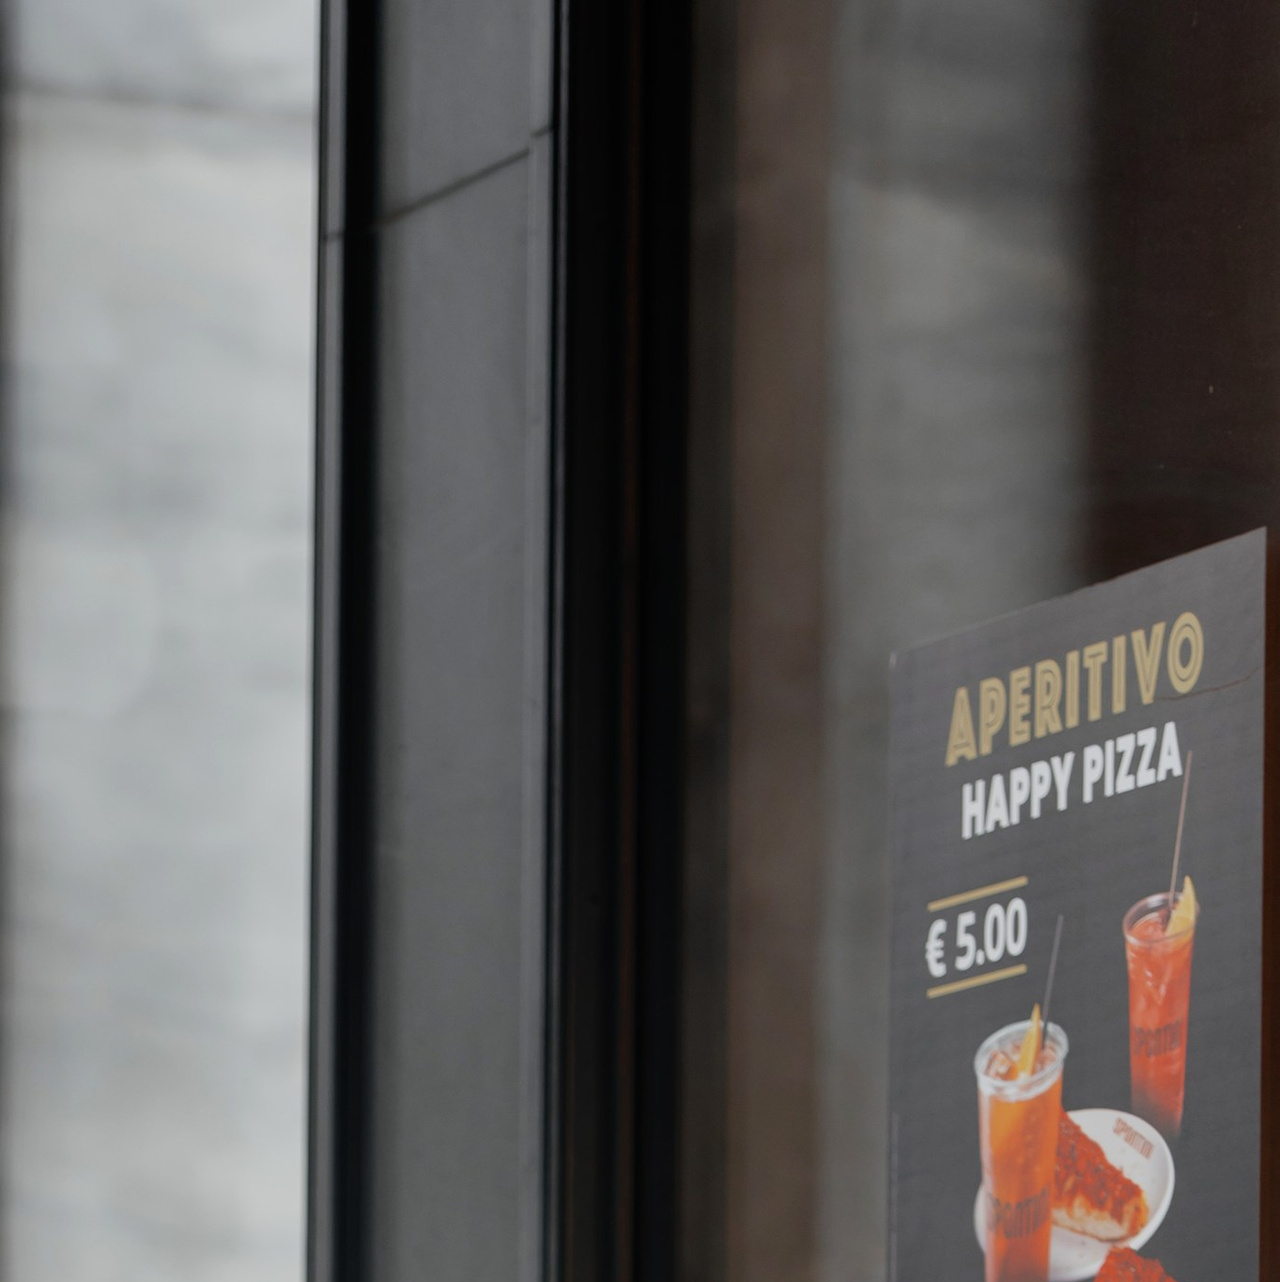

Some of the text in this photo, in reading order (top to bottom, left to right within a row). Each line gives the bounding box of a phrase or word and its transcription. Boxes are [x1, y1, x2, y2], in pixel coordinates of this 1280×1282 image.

[945, 611, 1205, 767] APERITIVO
[961, 721, 1184, 840] HAPPY PIZZA
[925, 897, 1029, 978] € 5.00
